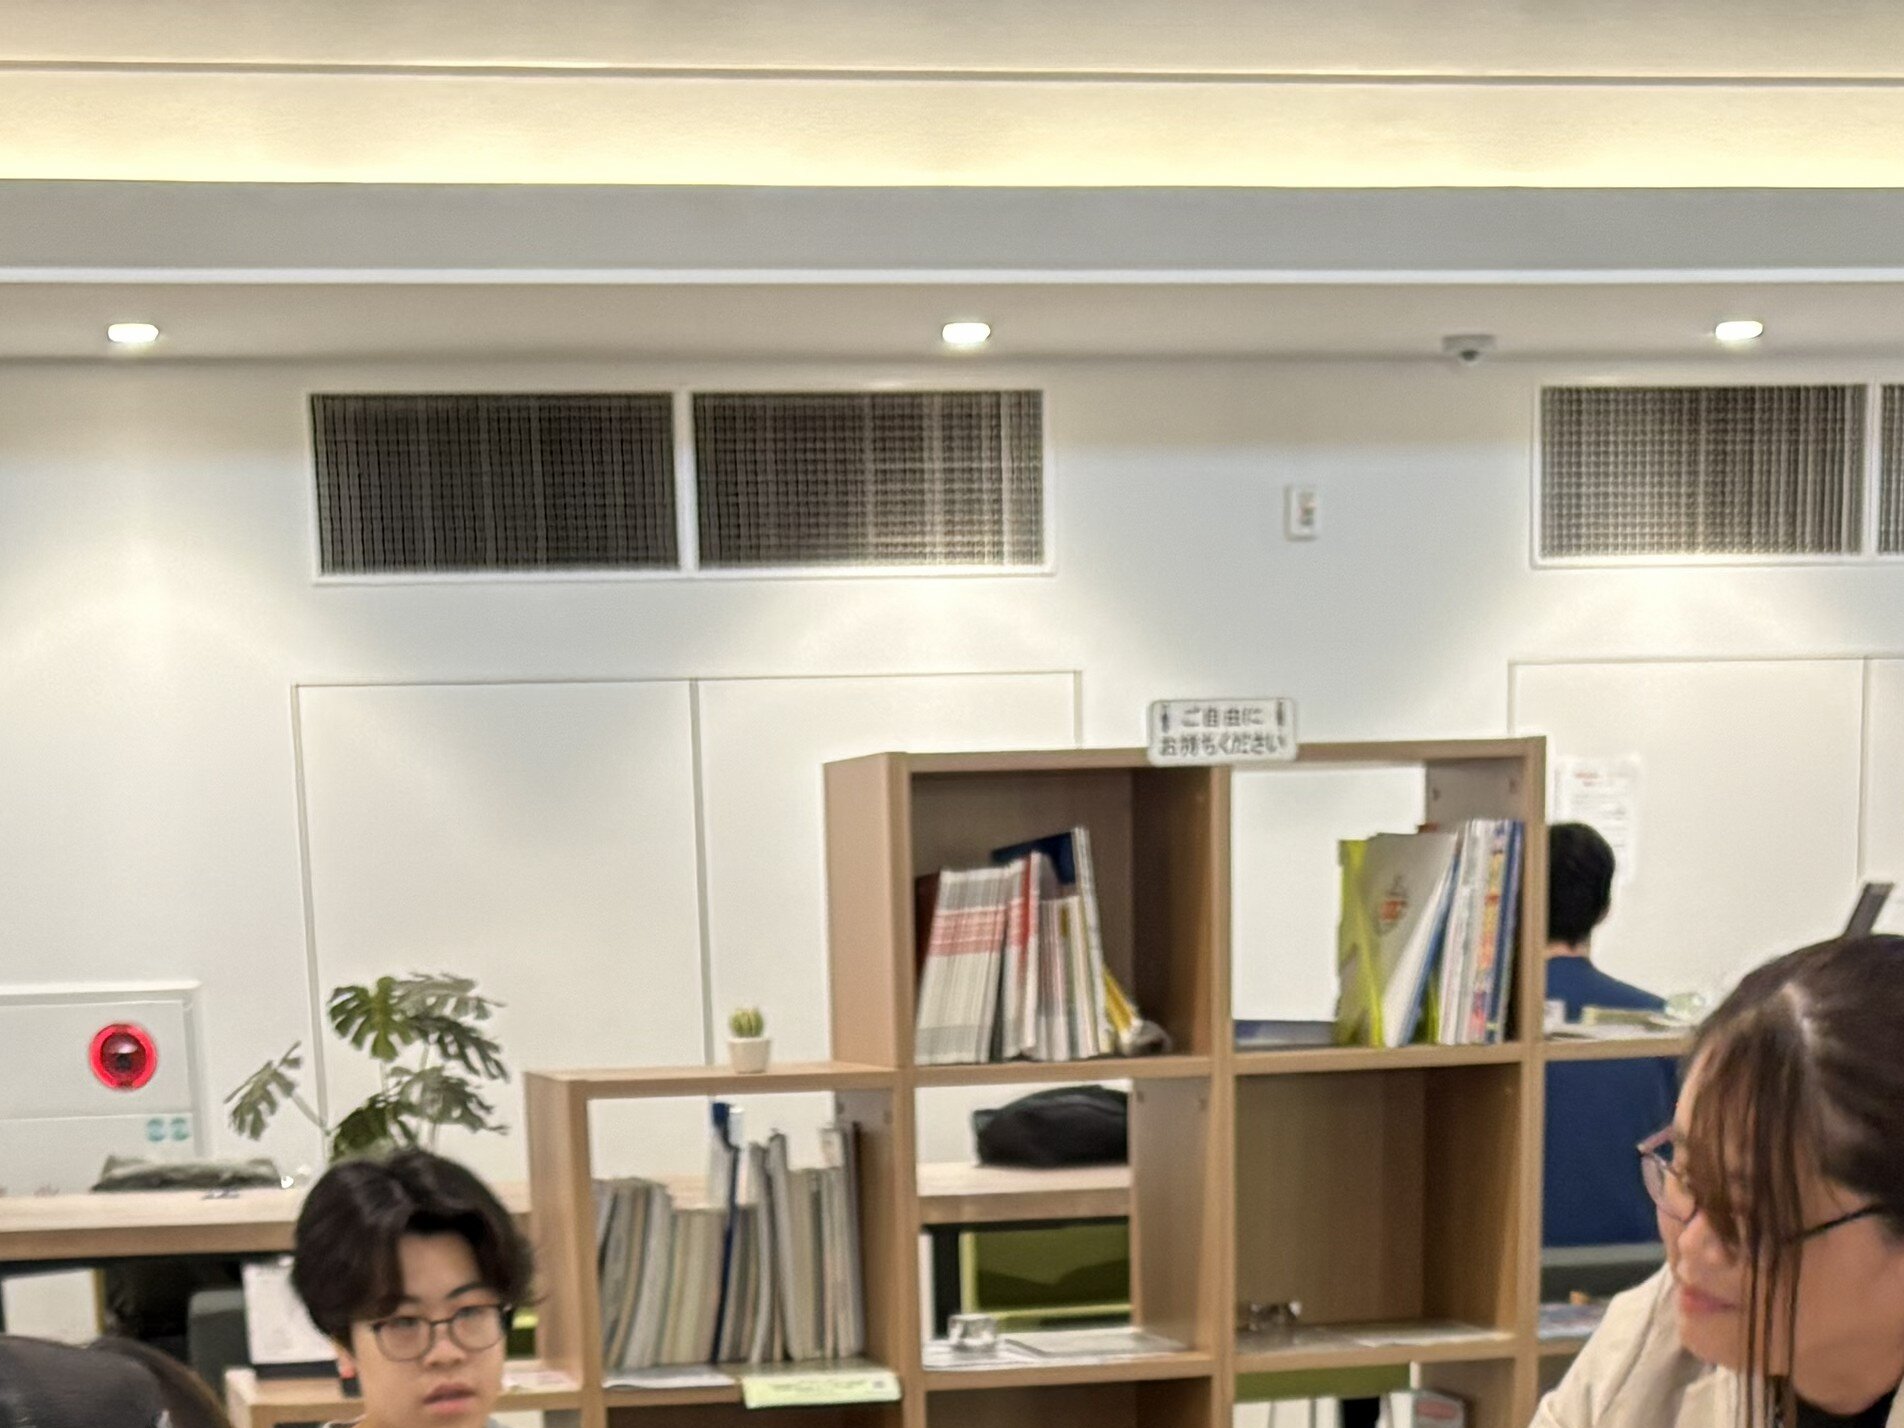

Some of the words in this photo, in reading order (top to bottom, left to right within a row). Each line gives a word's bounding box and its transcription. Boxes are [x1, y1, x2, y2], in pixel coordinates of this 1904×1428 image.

[1181, 706, 1264, 728] ご自由に
[1159, 732, 1287, 757] お持ちください
